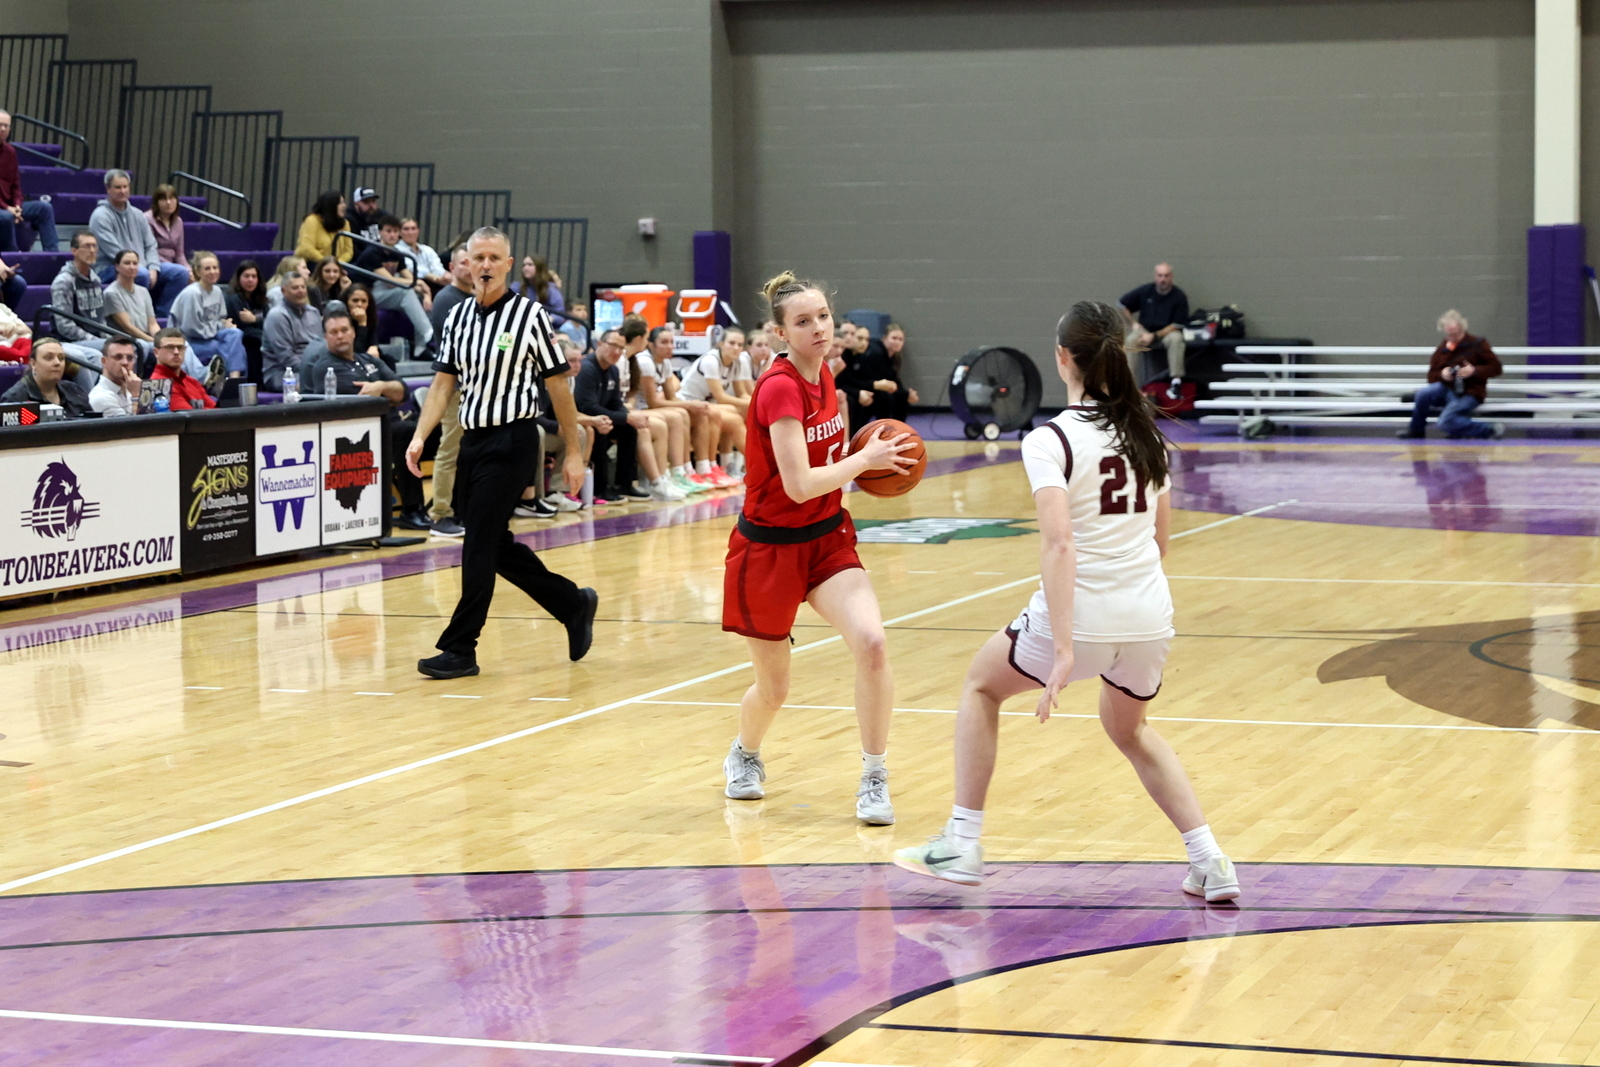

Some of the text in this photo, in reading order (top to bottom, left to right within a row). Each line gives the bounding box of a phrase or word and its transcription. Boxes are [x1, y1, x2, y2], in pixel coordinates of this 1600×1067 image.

[206, 451, 249, 467] MASTERPIECE
[329, 450, 374, 473] FARMERS
[261, 474, 315, 493] Wannemacher
[324, 467, 379, 491] EQUIPMENT
[1099, 455, 1147, 516] 21
[187, 464, 249, 531] SIGNS
[0, 535, 174, 586] TONBEAVERS.COM
